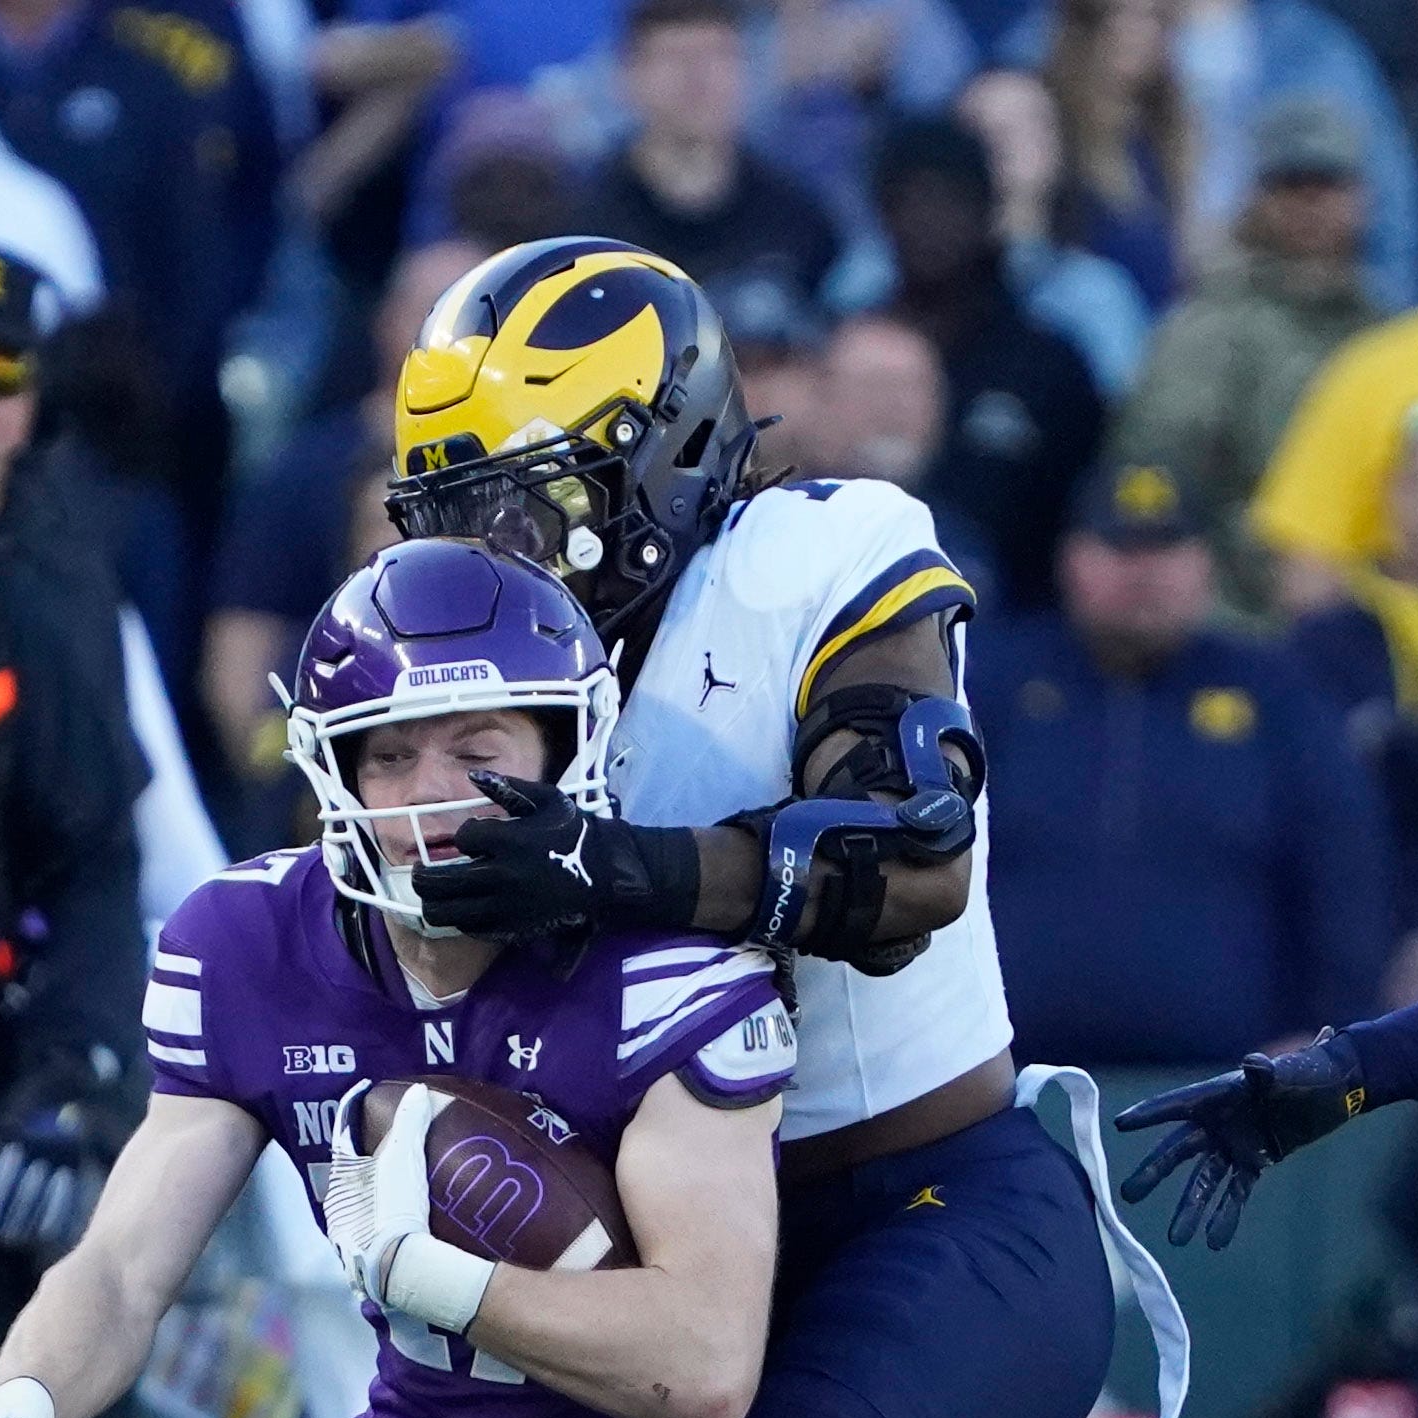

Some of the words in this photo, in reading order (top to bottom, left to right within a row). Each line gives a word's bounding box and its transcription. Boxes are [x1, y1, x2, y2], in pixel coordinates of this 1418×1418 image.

[422, 442, 450, 470] M
[408, 665, 488, 687] WILDCATS
[764, 847, 796, 942] DONJOY
[424, 1020, 455, 1065] N
